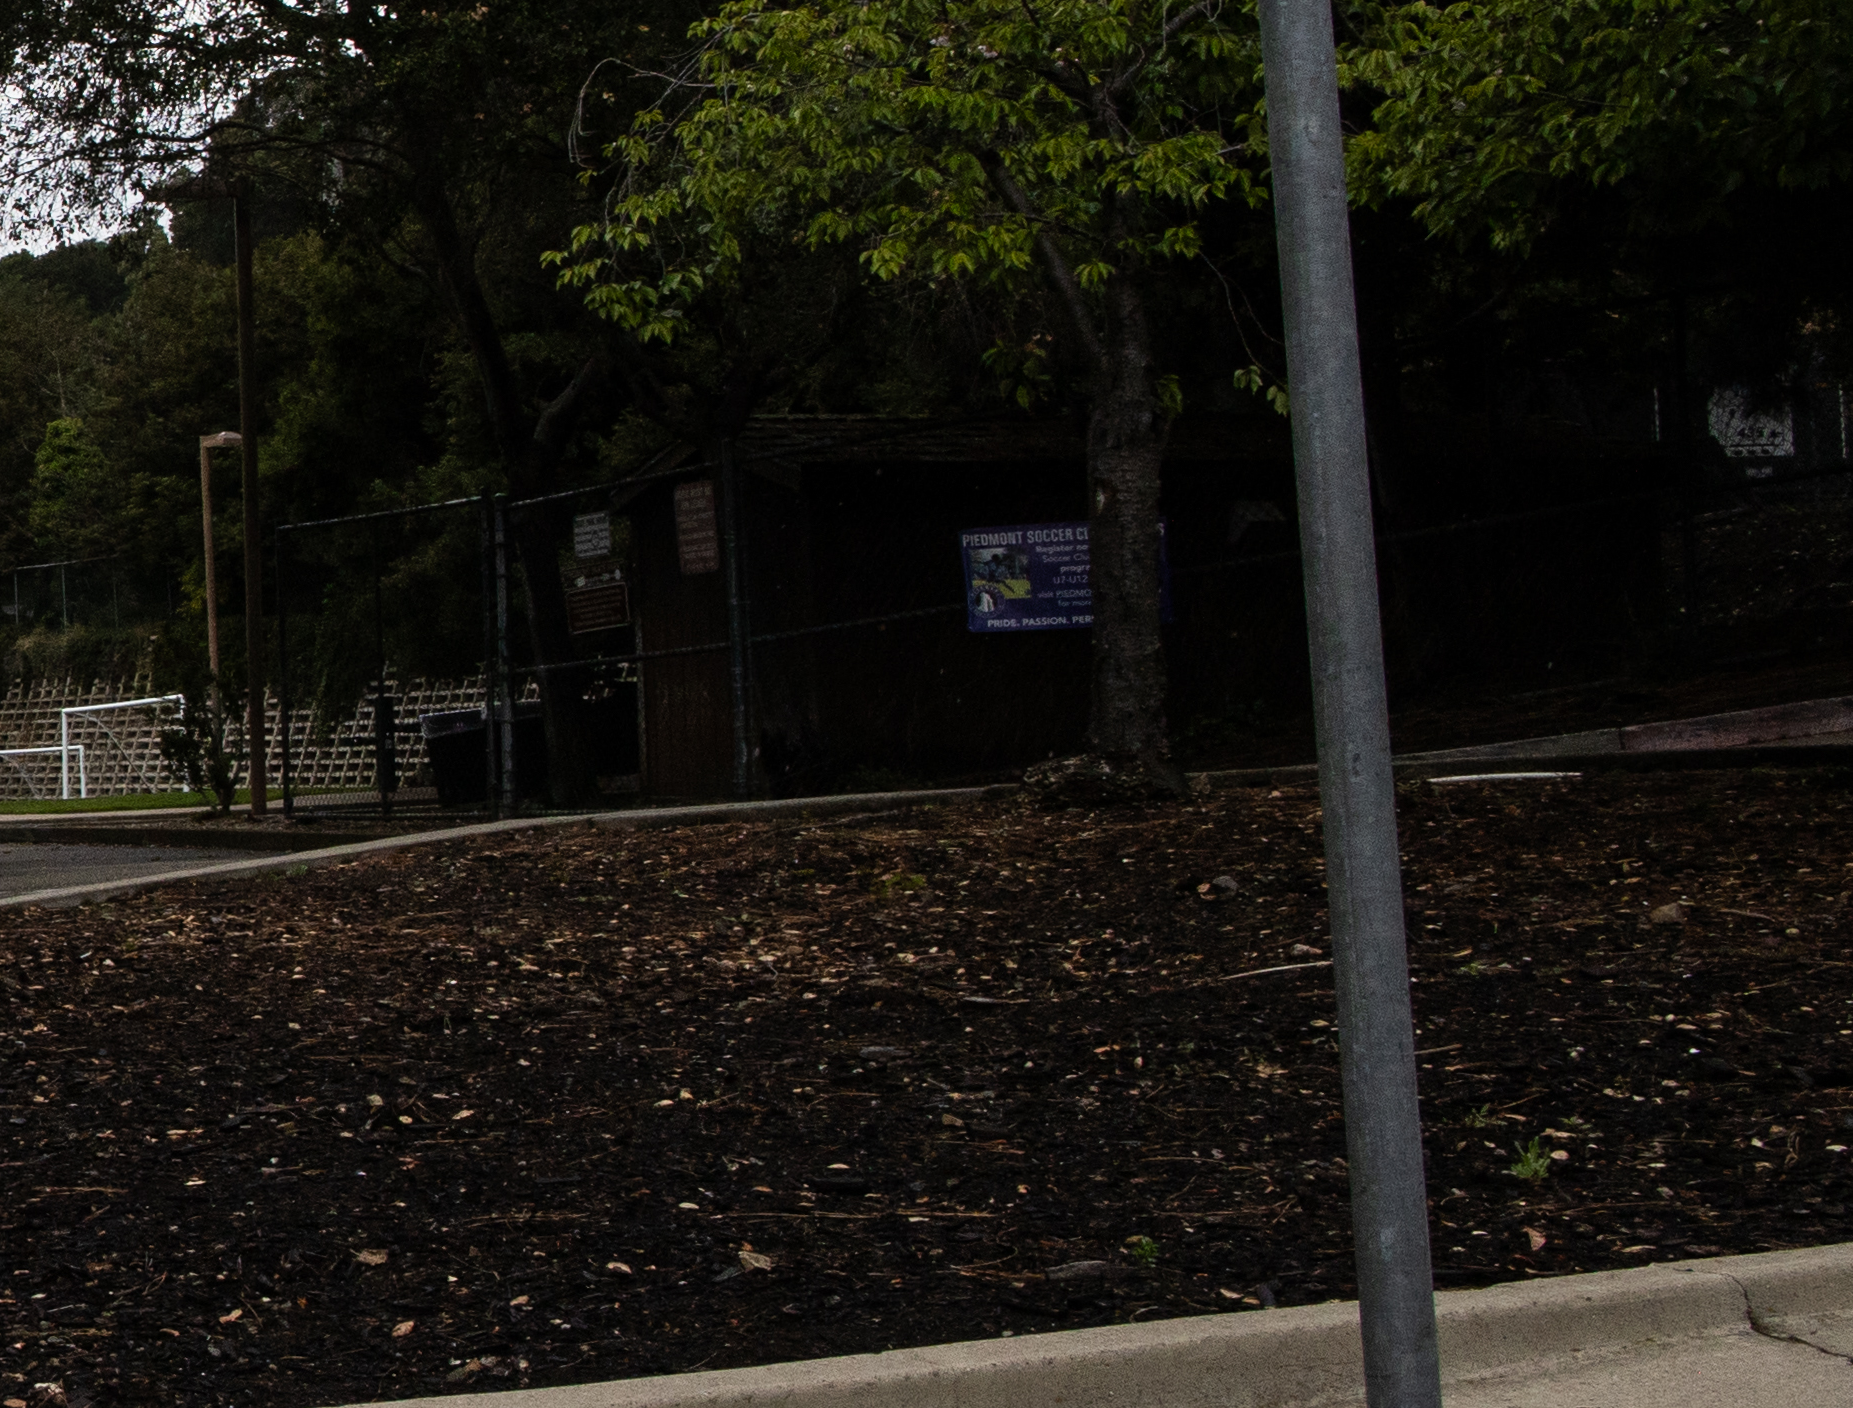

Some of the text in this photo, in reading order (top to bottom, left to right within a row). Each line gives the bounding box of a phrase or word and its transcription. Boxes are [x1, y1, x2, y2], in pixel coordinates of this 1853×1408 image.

[962, 532, 1023, 547] PIEDMONT
[1026, 528, 1074, 544] SOCCER
[1056, 588, 1092, 598] PIEDMO
